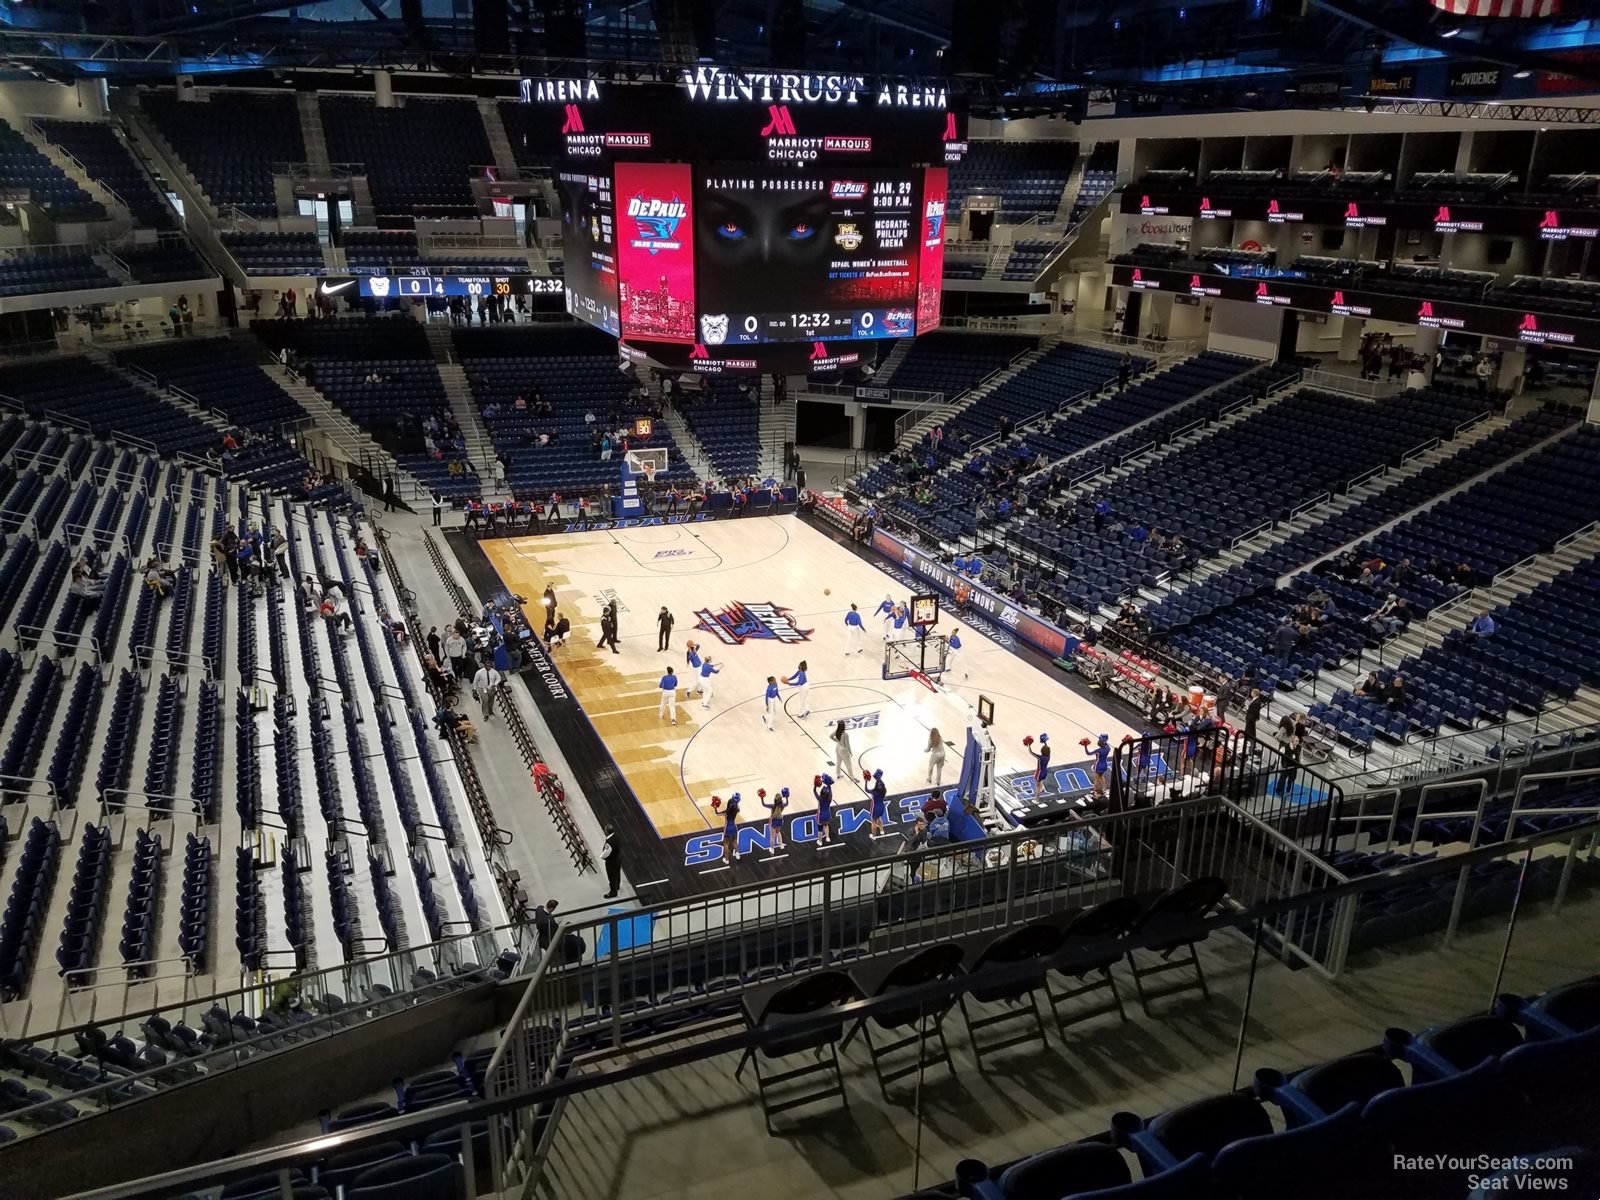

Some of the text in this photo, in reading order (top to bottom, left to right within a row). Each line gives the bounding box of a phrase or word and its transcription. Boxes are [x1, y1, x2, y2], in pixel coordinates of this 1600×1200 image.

[1450, 71, 1499, 87] OVIDENCE
[537, 79, 600, 101] ARENA
[683, 66, 948, 108] WINTRUST ARENA
[567, 135, 649, 145] MARRIOTT MARQUIS
[768, 138, 870, 149] MARRIOTT MARQUIS
[567, 146, 601, 155] CHICAGO
[768, 150, 818, 159] CHICAGO
[706, 179, 824, 190] PLAYING POSSESSED
[873, 182, 912, 194] JAN. 29
[895, 196, 912, 207] P.M.
[876, 229, 908, 238] PHILLIPS
[1168, 224, 1192, 233] LIGHT
[880, 239, 904, 248] ARENA
[411, 279, 564, 294] 0 4 00 30 12:32
[744, 315, 758, 333] 0
[791, 313, 830, 328] 12:32
[861, 312, 874, 328] 0
[1520, 335, 1545, 343] CHICAGO
[1521, 330, 1574, 342] MARRIOTT MARQUIS
[693, 359, 725, 367] MARRIOTT
[919, 560, 944, 583] DEPAUL
[1002, 605, 1019, 617] BIG
[1000, 612, 1021, 625] EAST
[961, 615, 1012, 645] CHICAGO
[542, 672, 568, 699] COURT
